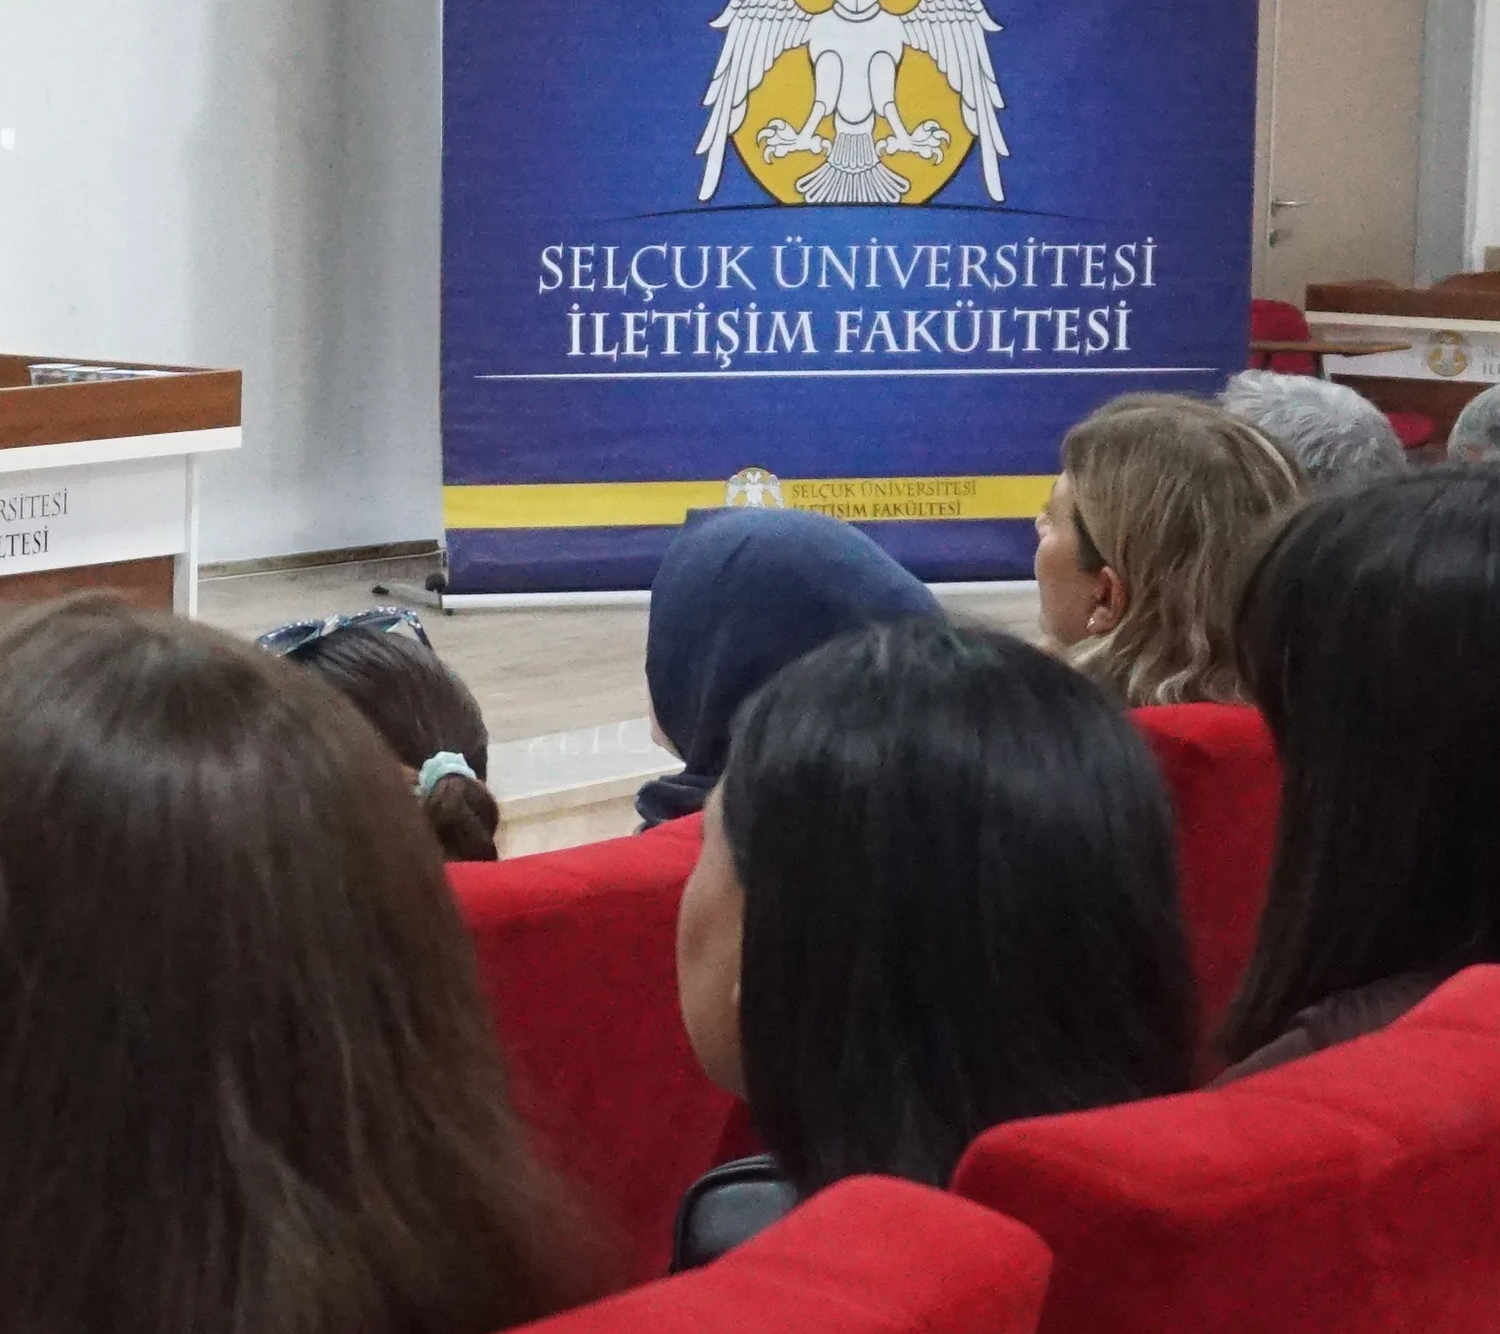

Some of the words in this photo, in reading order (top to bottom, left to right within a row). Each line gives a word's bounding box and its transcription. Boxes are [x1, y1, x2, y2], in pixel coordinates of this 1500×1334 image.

[538, 243, 757, 302] SELÇUK
[772, 236, 1159, 291] ÜNİVERSİTESİ
[566, 302, 818, 367] İLETİŞİM
[835, 299, 1133, 356] FAKÜLTESİ
[792, 483, 857, 501] SELÇUK
[861, 479, 977, 497] ÜNİVERSİTESİ
[793, 501, 868, 519] TİŞİM
[873, 499, 962, 517] FAKÜLTESİ
